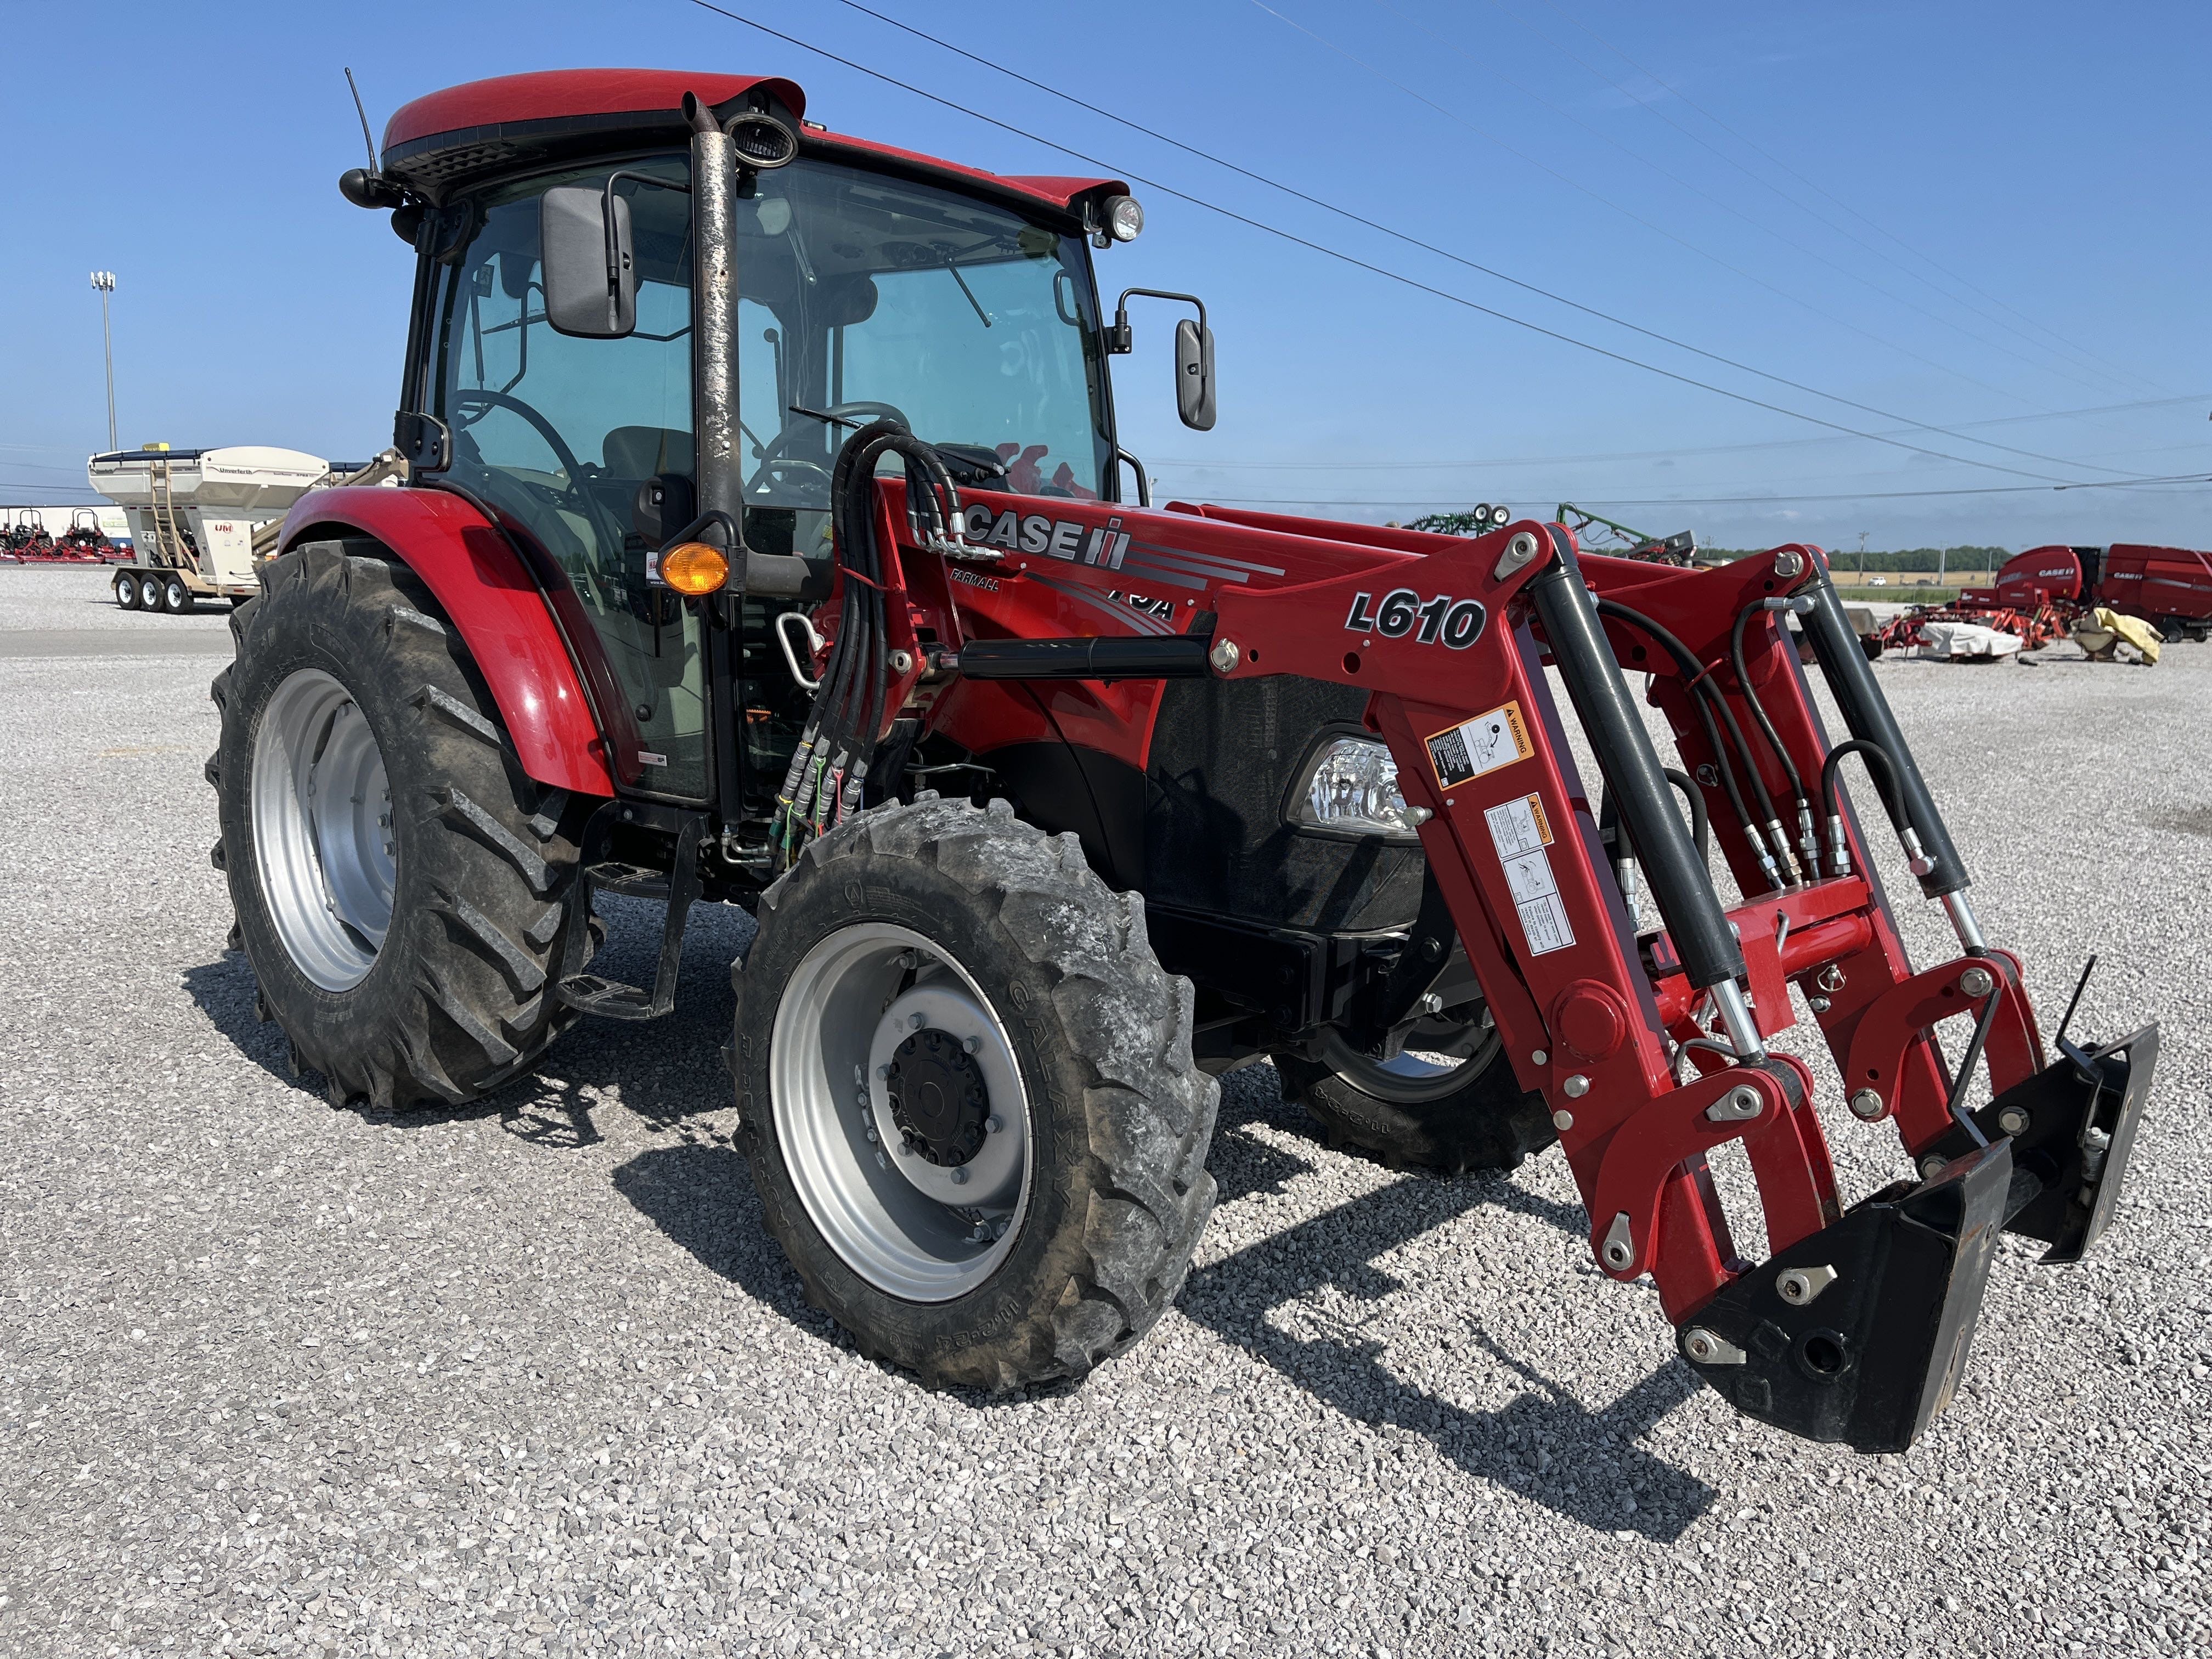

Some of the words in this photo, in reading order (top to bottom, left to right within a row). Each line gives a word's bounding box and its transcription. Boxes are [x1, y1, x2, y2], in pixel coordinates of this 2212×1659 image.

[963, 504, 1084, 561] CASE
[950, 568, 998, 592] FARMALL
[2039, 569, 2064, 577] CASE
[1344, 588, 1487, 650] L610
[1510, 716, 1527, 754] WARNING
[1533, 808, 1548, 839] WARNING
[1009, 979, 1075, 1209] GALAXY
[935, 1298, 1022, 1350] 11.2-24
